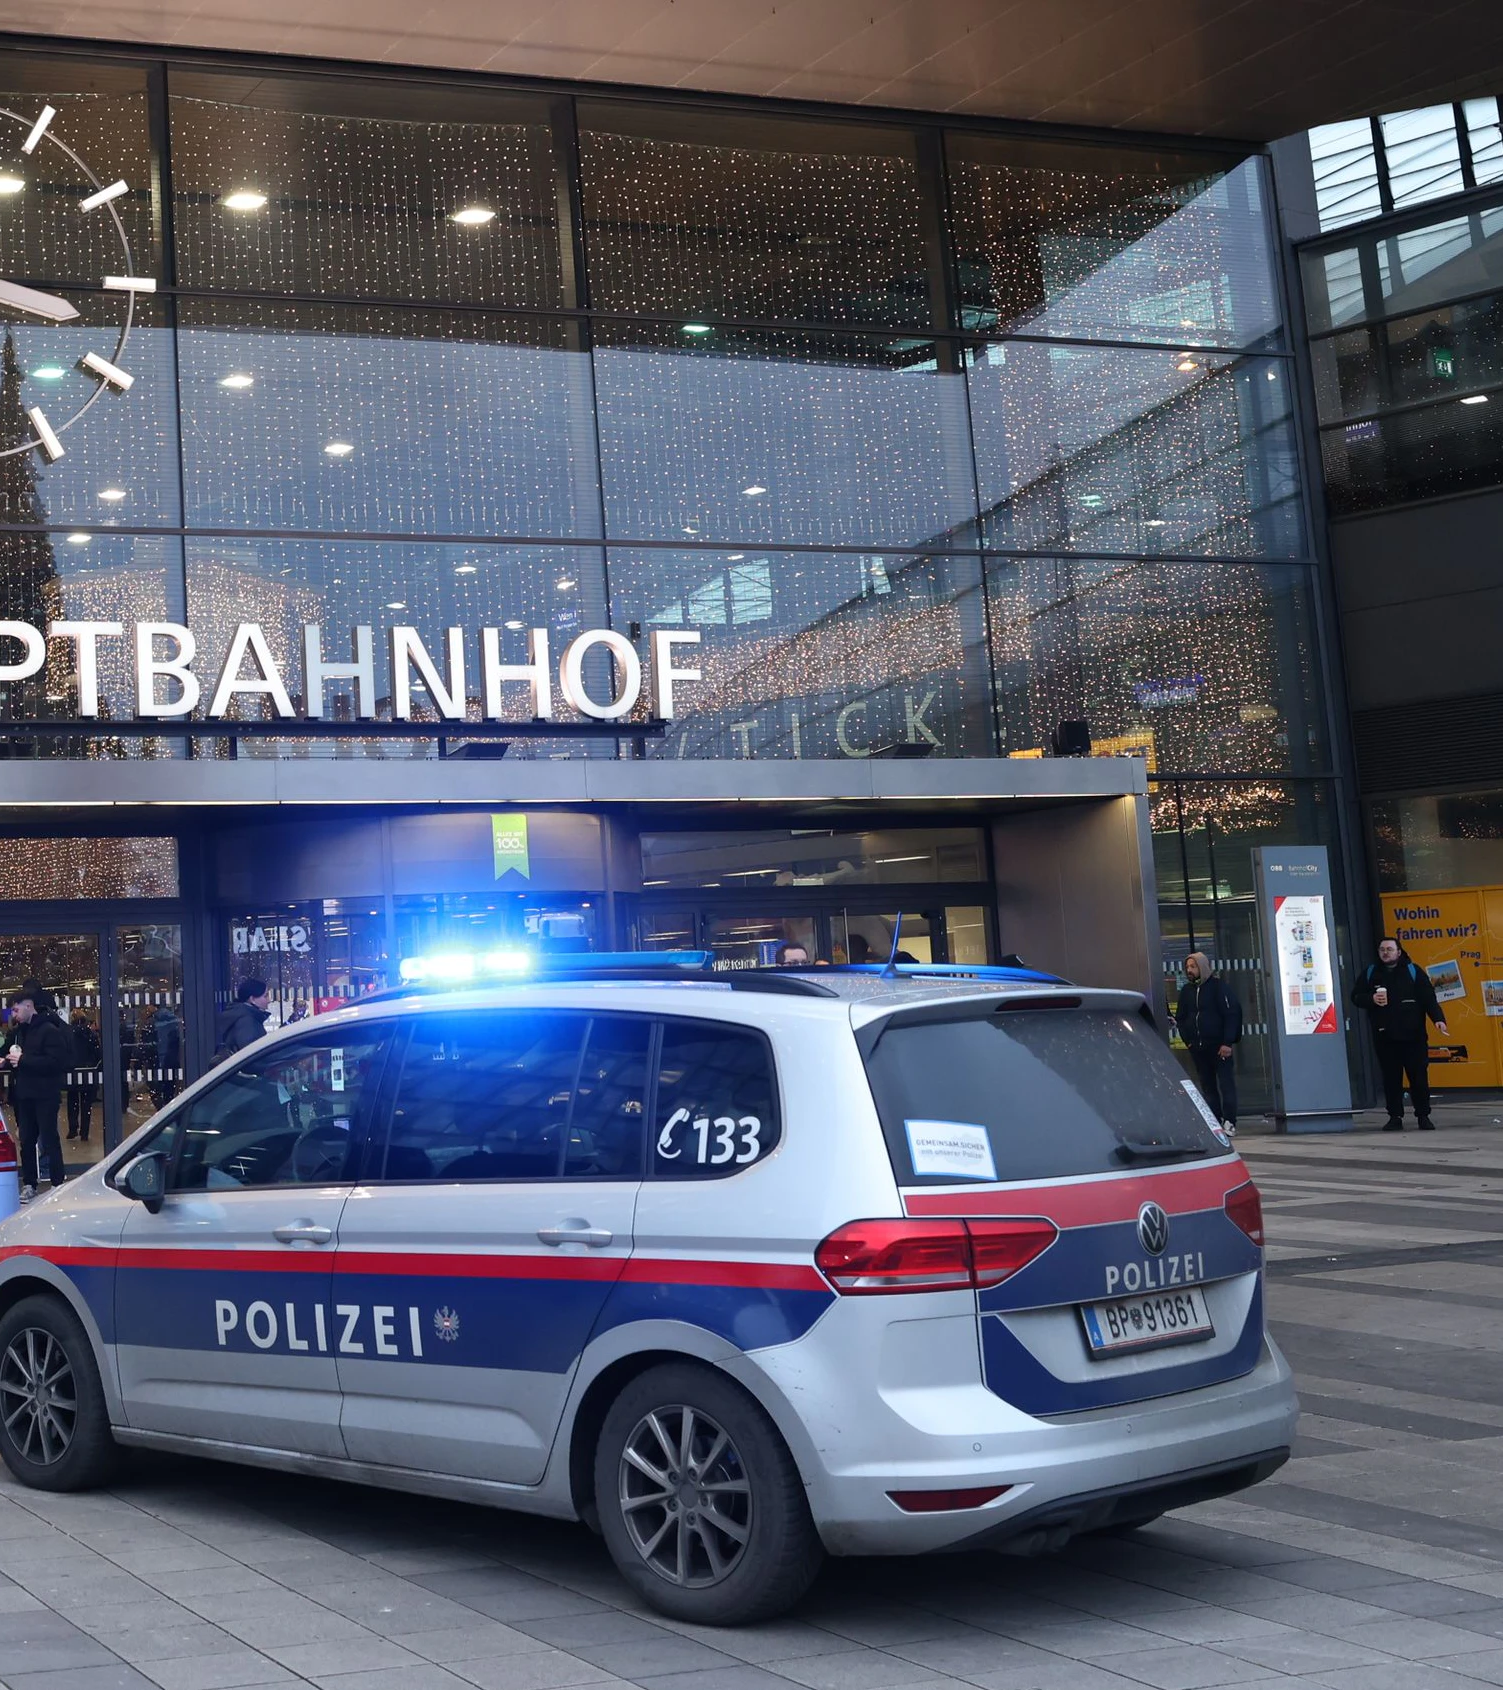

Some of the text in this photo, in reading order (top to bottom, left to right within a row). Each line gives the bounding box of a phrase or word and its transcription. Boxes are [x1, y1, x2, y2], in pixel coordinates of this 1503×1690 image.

[1394, 906, 1440, 921] Wohin
[1396, 923, 1478, 941] fahren wir?
[1460, 950, 1481, 961] Prag
[692, 1116, 761, 1164] 133
[1105, 1252, 1204, 1294] POLIZEI
[215, 1299, 423, 1357] POLIZEI
[1143, 1294, 1198, 1331] 91361
